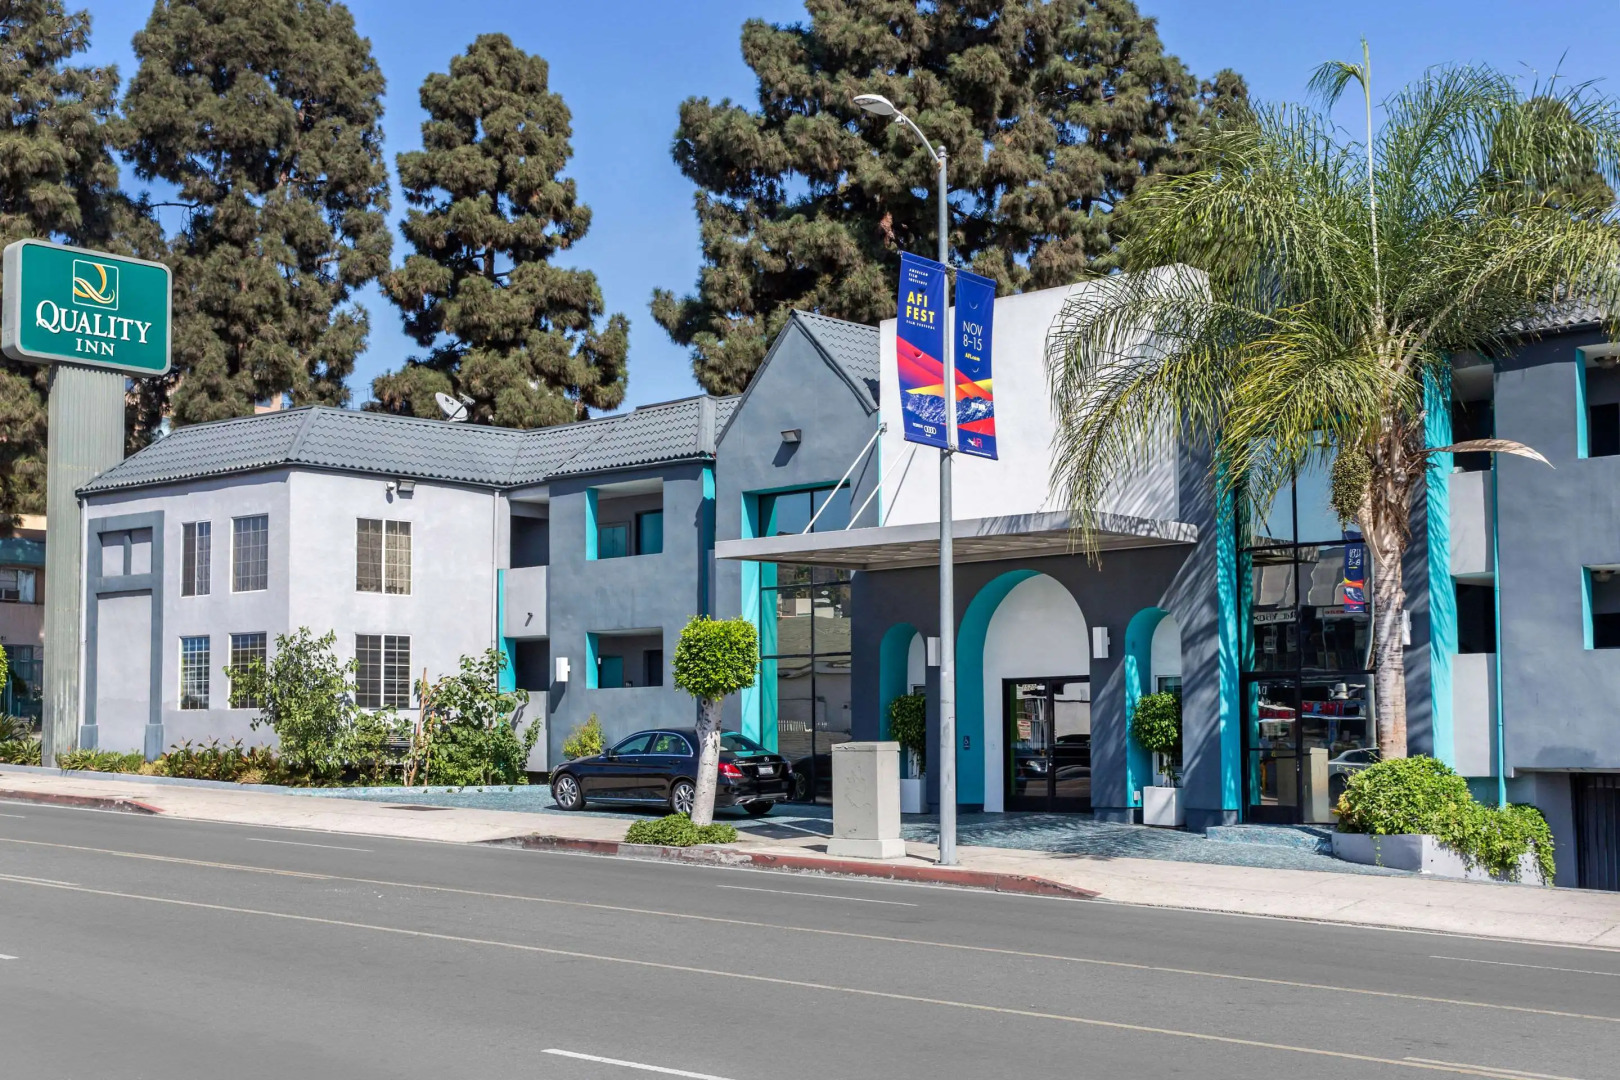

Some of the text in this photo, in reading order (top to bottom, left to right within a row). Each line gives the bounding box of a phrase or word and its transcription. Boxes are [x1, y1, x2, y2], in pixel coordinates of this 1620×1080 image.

[907, 291, 928, 308] AFI
[36, 299, 153, 344] QUALITY
[906, 305, 935, 324] FEST
[962, 320, 983, 337] NOV
[75, 337, 115, 357] INN
[962, 333, 983, 351] 8-15
